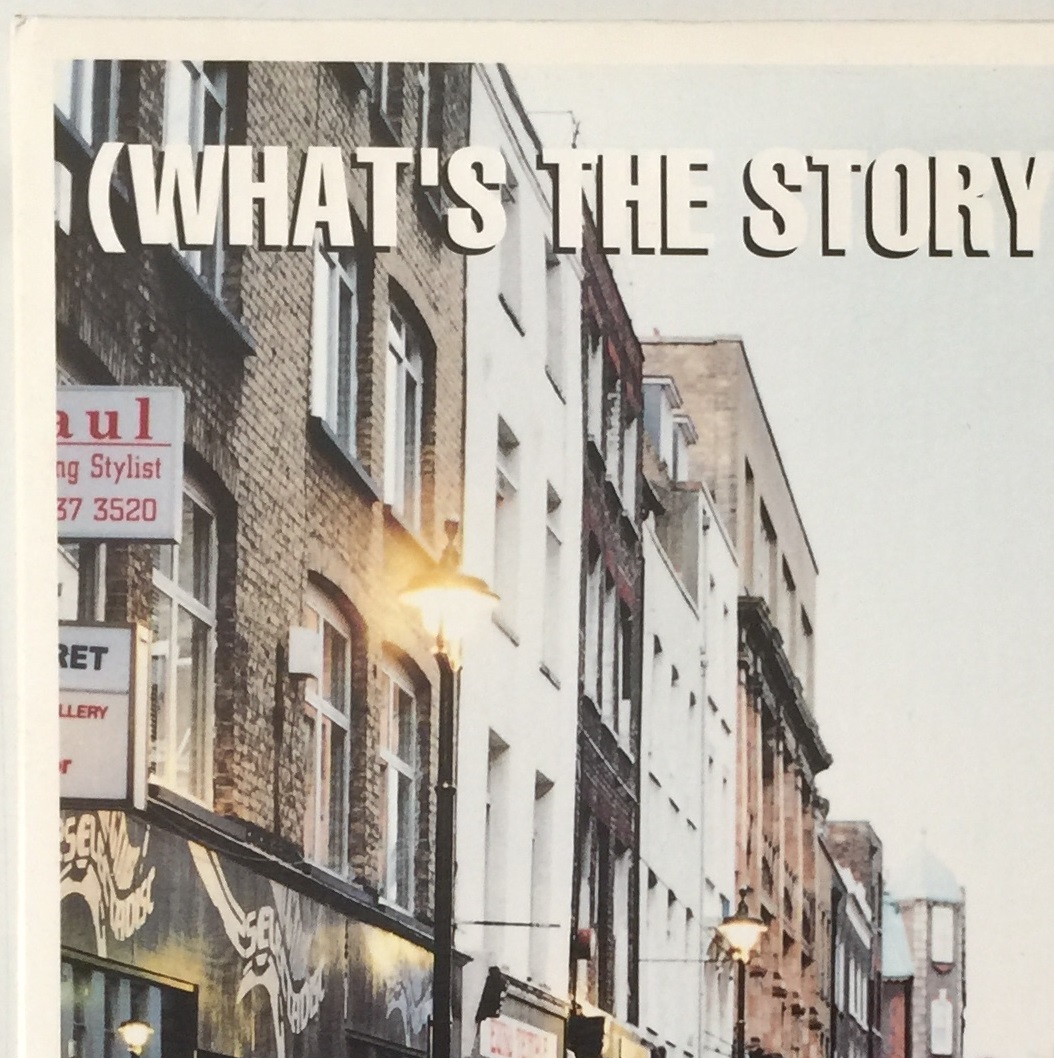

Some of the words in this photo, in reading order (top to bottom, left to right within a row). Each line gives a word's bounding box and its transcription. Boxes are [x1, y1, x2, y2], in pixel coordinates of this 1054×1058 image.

[87, 142, 507, 255] (WHAT'S
[536, 146, 715, 256] THE
[90, 453, 162, 485] Stylist
[57, 497, 83, 521] 37
[93, 497, 157, 522] 3520
